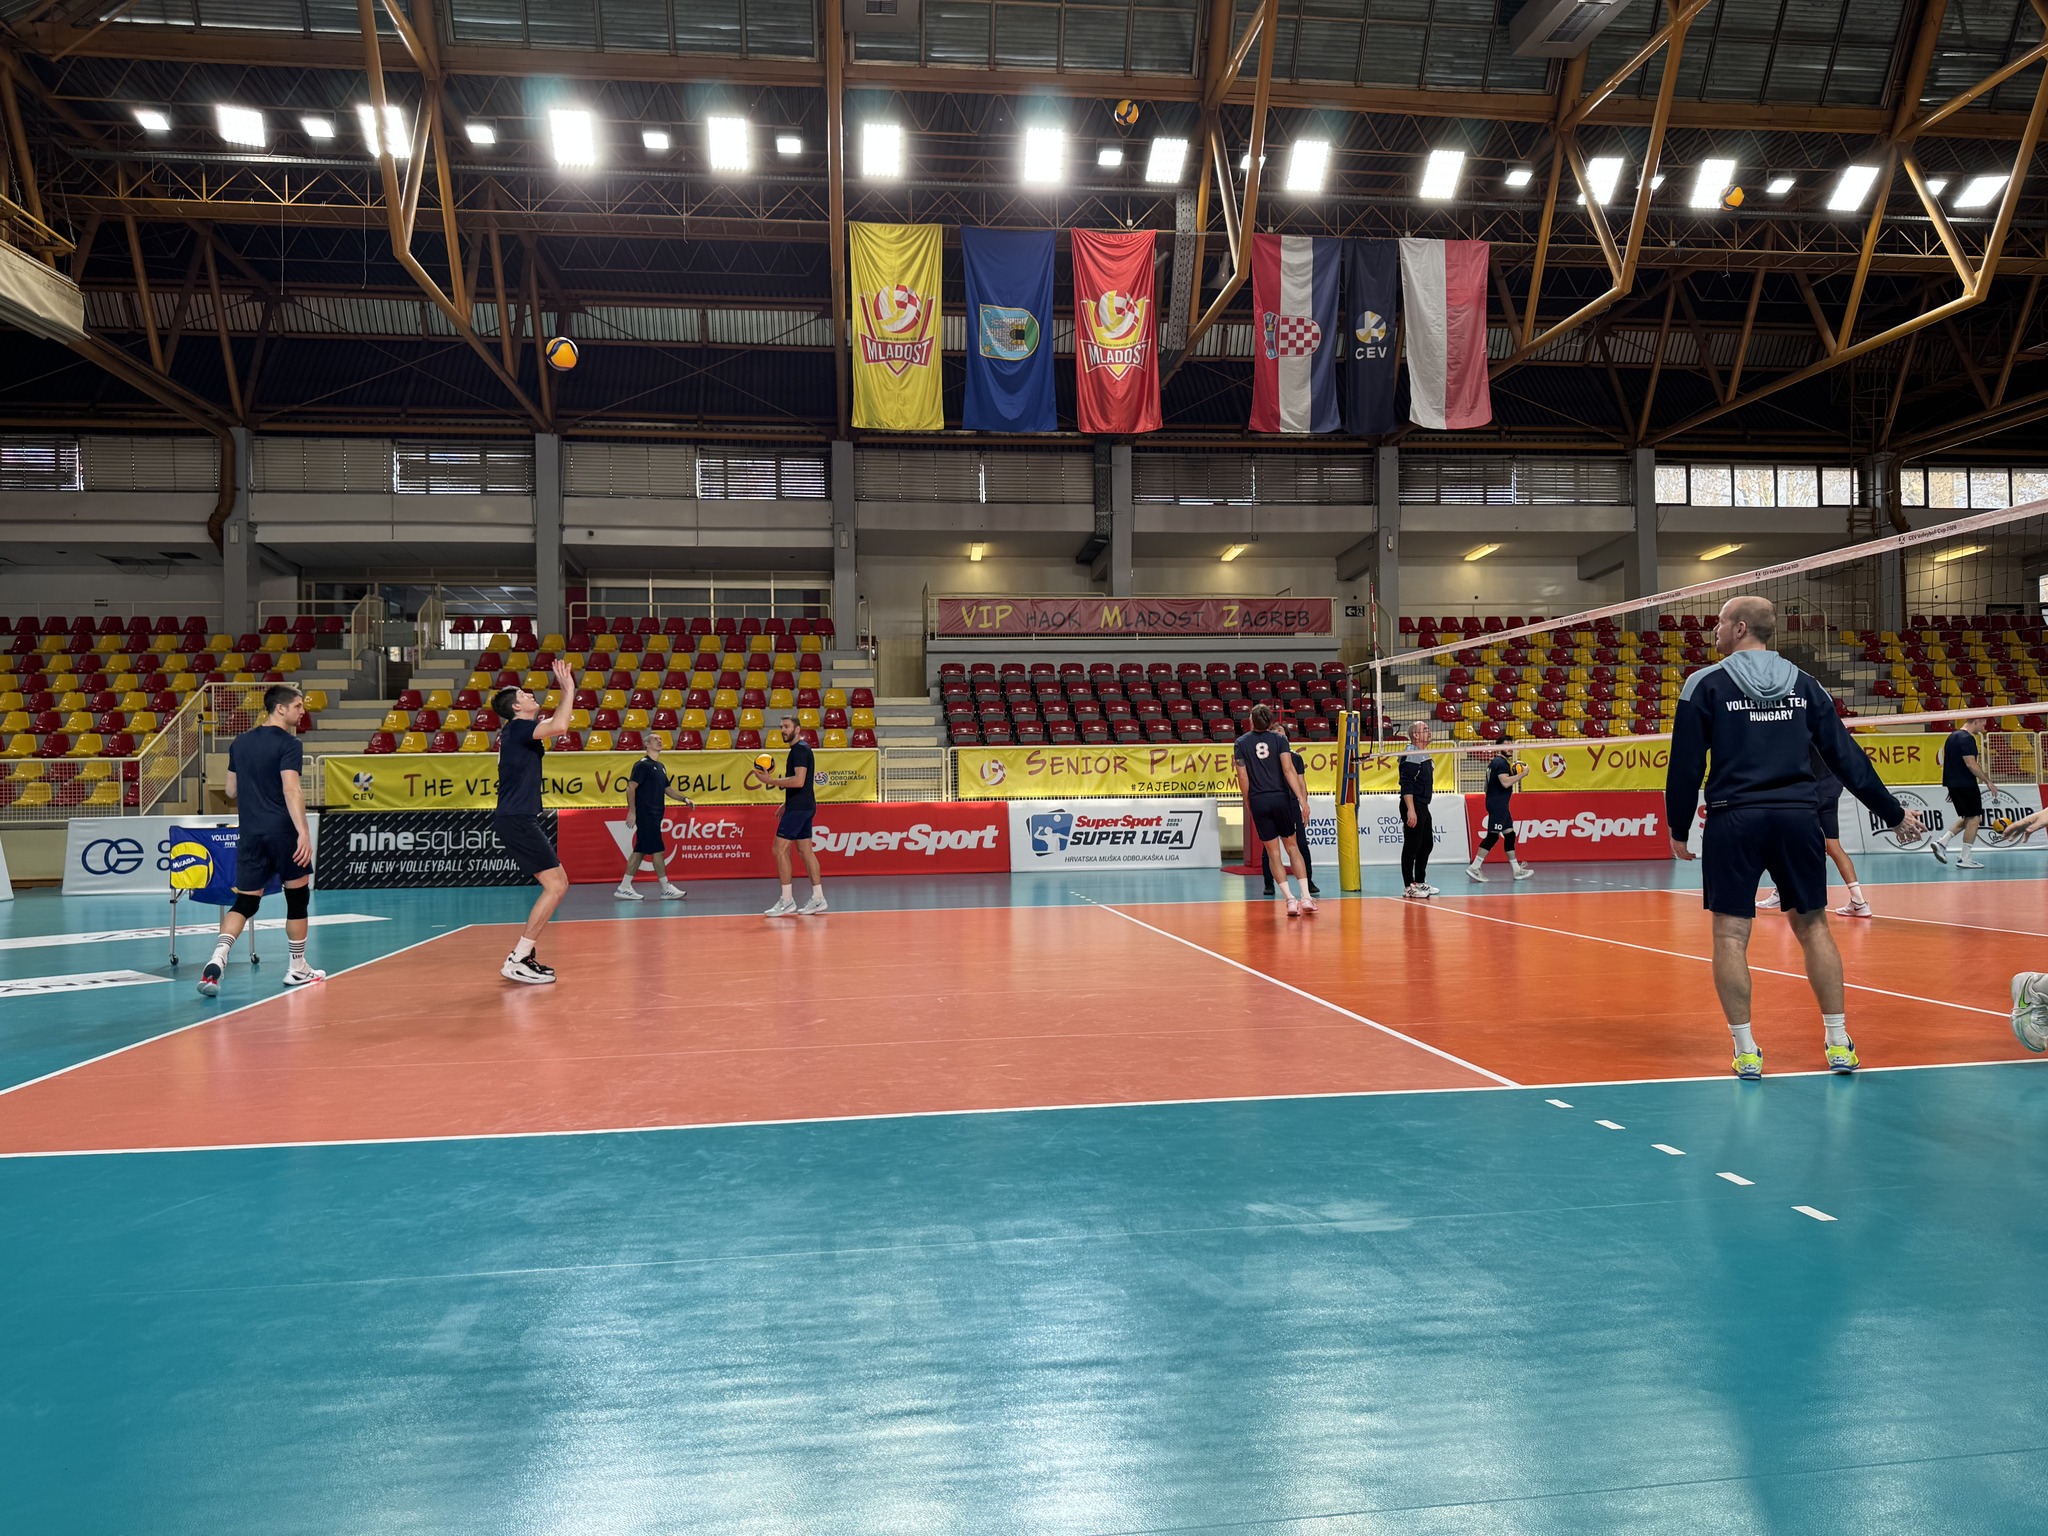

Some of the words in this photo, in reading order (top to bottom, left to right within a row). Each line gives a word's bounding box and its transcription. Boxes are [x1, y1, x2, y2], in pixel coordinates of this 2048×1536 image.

[866, 338, 930, 364] MLADOST
[1087, 343, 1147, 366] MLADOST
[1355, 347, 1387, 360] CEV
[961, 605, 1013, 629] VIP
[1026, 610, 1081, 629] HAOK
[1100, 605, 1204, 629] MLADOST
[1222, 605, 1310, 628] ZAGREB
[1750, 710, 1793, 721] HUNGARY
[1255, 742, 1270, 759] 8
[1587, 745, 1669, 771] YOUNG
[1864, 746, 1921, 764] RNER
[1026, 750, 1128, 775] SENIOR
[404, 774, 454, 797] THE
[466, 777, 583, 796] VISING
[660, 817, 736, 839] Paket
[729, 826, 745, 838] 24
[1075, 815, 1162, 830] SuperSport
[350, 825, 506, 857] ninesquare
[811, 823, 999, 857] SuperSport
[1070, 831, 1136, 845] SUPER
[1140, 831, 1184, 844] LIGA
[349, 861, 367, 874] THE
[371, 861, 396, 873] NEW
[400, 860, 463, 873] VOLLEYBALL
[467, 859, 520, 871] STANDAR
[1099, 854, 1121, 862] MUŠKA
[1122, 853, 1164, 861] ODBOJKAŠKA
